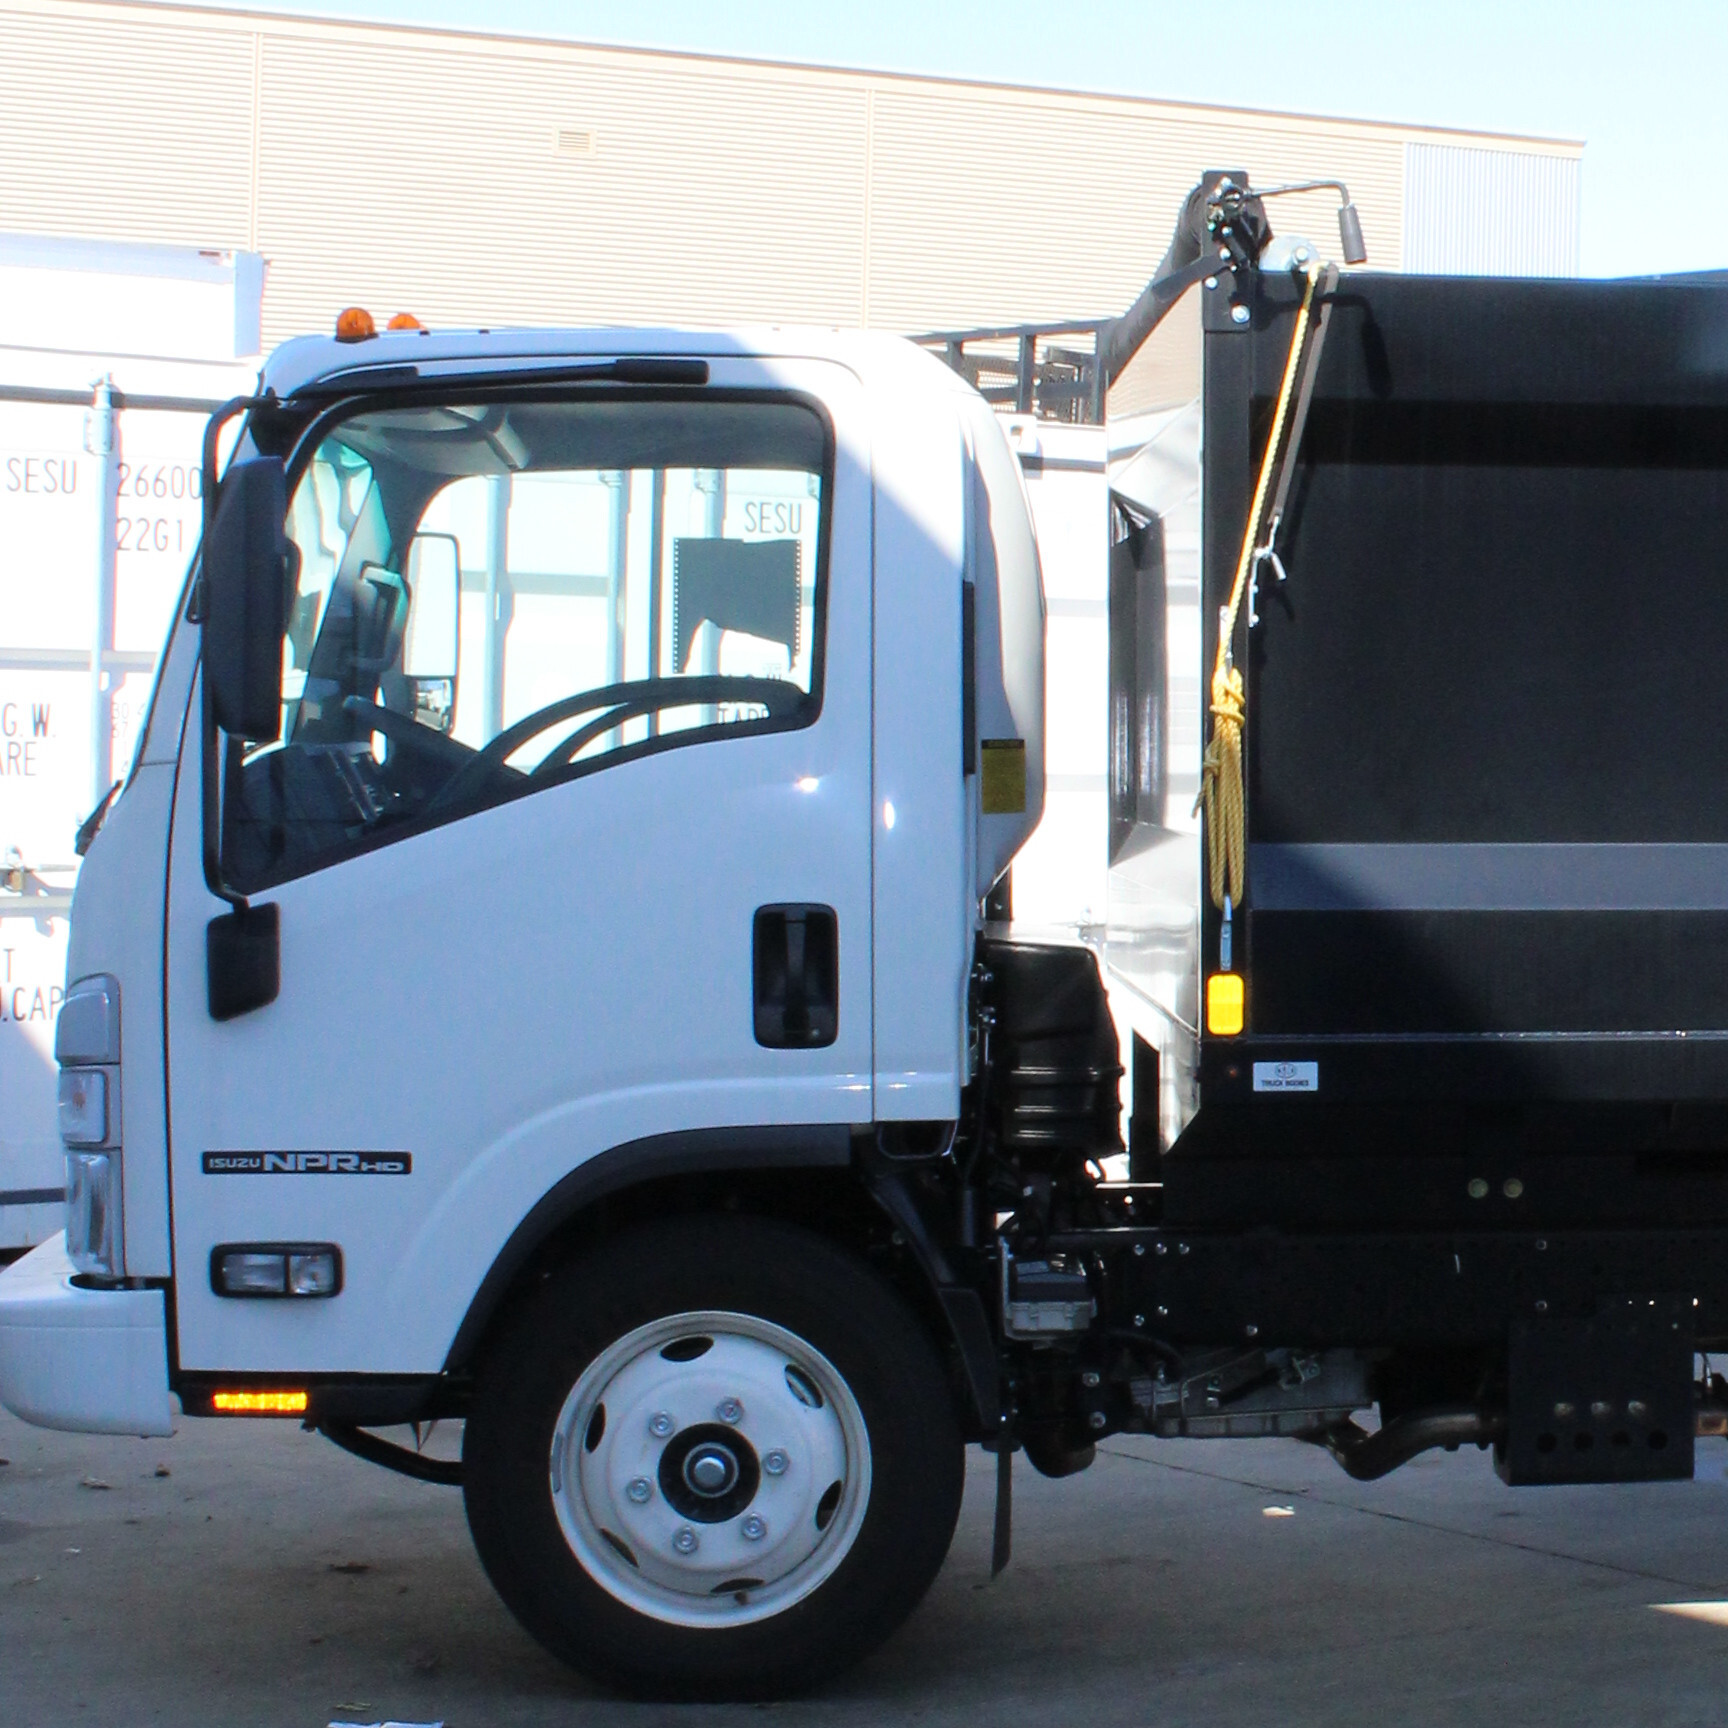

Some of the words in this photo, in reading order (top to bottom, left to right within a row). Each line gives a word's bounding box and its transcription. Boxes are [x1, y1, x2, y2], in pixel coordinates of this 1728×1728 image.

[6, 457, 77, 494] SESU
[744, 501, 802, 534] SESU
[208, 1157, 261, 1169] ISUZU
[262, 1152, 361, 1172] NPR
[360, 1160, 405, 1172] HD
